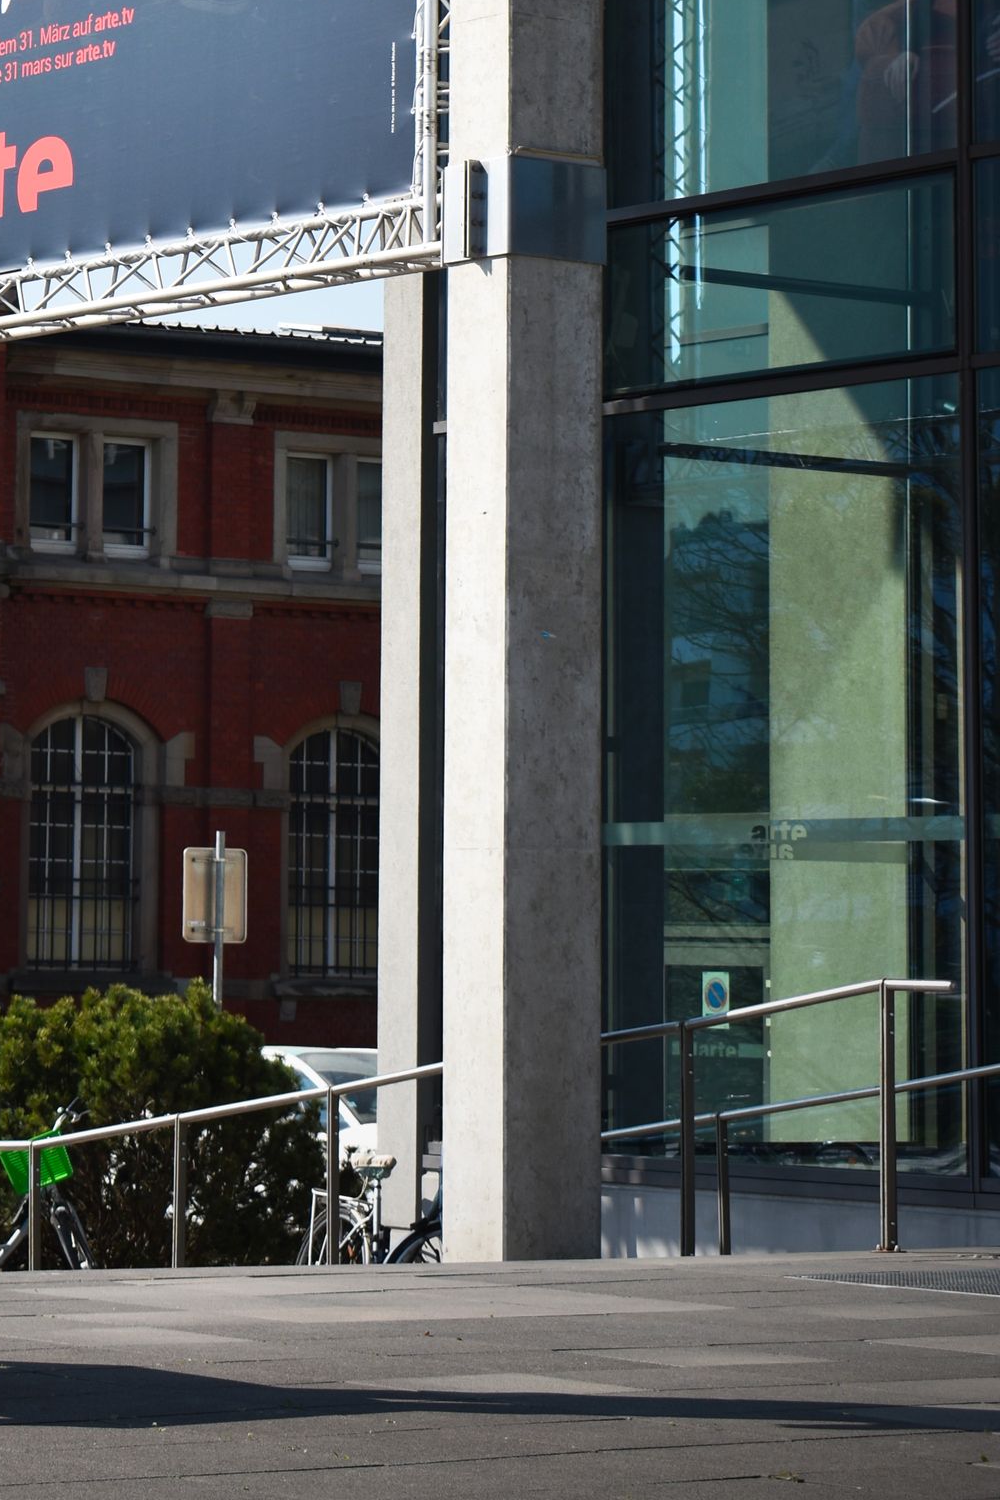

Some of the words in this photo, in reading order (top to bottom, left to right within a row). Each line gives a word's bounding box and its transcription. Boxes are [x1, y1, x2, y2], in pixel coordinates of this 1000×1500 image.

[19, 29, 38, 52] 31.
[40, 23, 70, 46] März
[72, 14, 94, 38] auf
[94, 7, 135, 33] arte.tv
[4, 60, 20, 82] 31
[21, 56, 53, 79] mars
[54, 49, 76, 70] sur
[75, 40, 116, 65] arte.tv
[751, 821, 807, 841] arte
